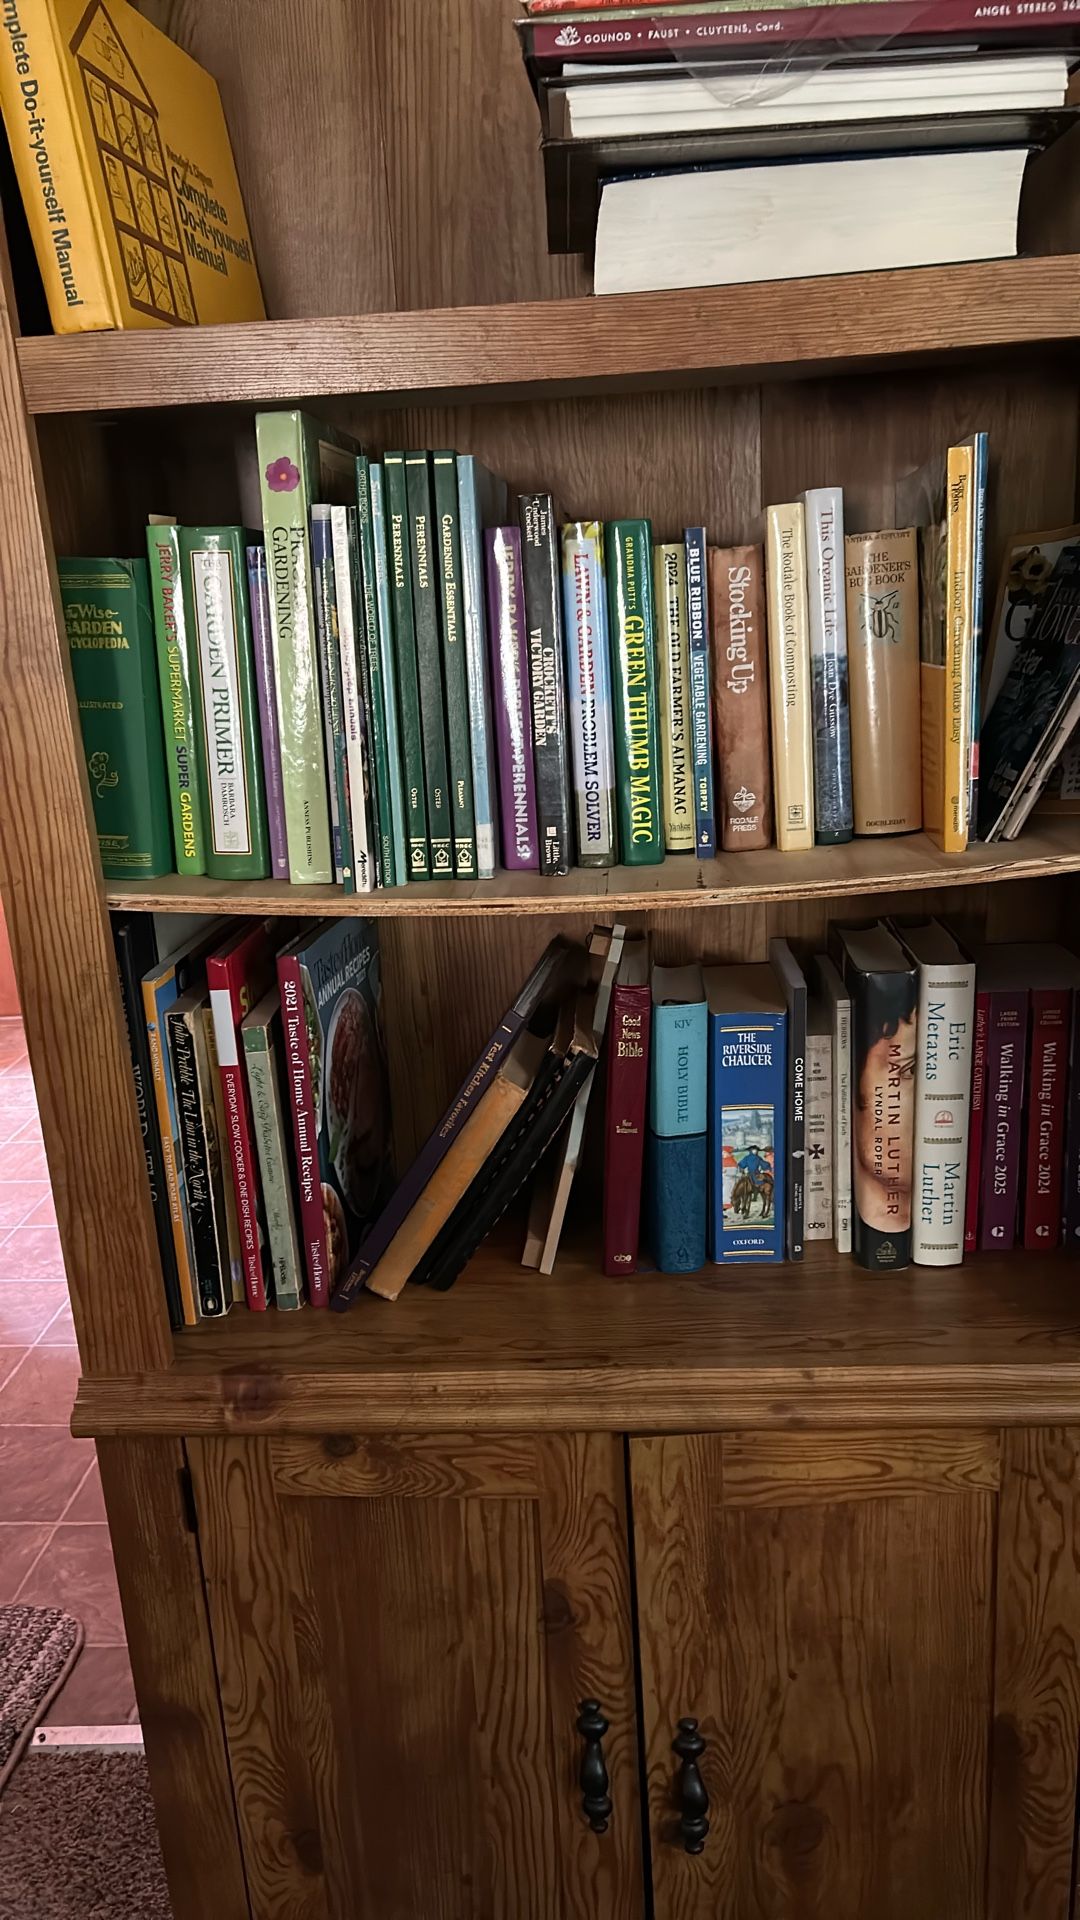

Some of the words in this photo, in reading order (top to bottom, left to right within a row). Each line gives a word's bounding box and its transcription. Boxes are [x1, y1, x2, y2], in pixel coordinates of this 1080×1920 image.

[974, 5, 1011, 17] ANGEL
[1016, 2, 1057, 14] STEREO
[584, 32, 631, 44] GOUNOD
[648, 29, 679, 40] FAUST
[756, 21, 784, 32] Cond.
[20, 79, 66, 224] Do-it-yourself
[51, 227, 84, 308] Manual
[172, 166, 229, 225] Complete
[178, 202, 251, 265] Do-it-yourself
[184, 234, 229, 277] Manual
[358, 469, 367, 496] ORTHO
[525, 506, 534, 542] Crockett
[532, 500, 541, 547] Underwood
[540, 509, 548, 536] James
[781, 528, 794, 549] The
[820, 507, 834, 542] This
[155, 542, 173, 583] JERRY
[391, 514, 405, 588] PERENNIALS
[415, 516, 429, 589] PERENNIALS
[442, 514, 454, 579] GARDENING
[625, 536, 634, 578] GRANDMA
[271, 526, 293, 640] GARDENING
[573, 553, 592, 604] LAWN
[689, 548, 701, 583] BLUE
[782, 551, 795, 590] Rodale
[817, 547, 835, 603] Organic
[875, 572, 905, 586] BOOK
[627, 581, 636, 610] PUTT'S
[784, 594, 796, 621] Book
[953, 570, 965, 612] Indoor
[78, 604, 119, 619] Wise
[160, 586, 176, 642] BAKER'S
[445, 582, 457, 642] ESSENTIALS
[575, 607, 592, 621] &
[669, 595, 680, 627] THE
[690, 586, 702, 640] RIBBON
[727, 567, 753, 662] Stocking
[785, 624, 797, 635] of
[823, 609, 836, 636] Life
[530, 628, 543, 689] VICTORY
[577, 627, 596, 695] GARDEN
[623, 615, 647, 687] GREEN
[669, 631, 681, 663] OLD
[952, 615, 965, 678] Gardening
[543, 648, 557, 735] CROCKETT'S
[693, 654, 706, 708] VEGETABLE
[727, 661, 754, 694] Up
[785, 639, 799, 707] Composting
[826, 681, 837, 700] Dye
[166, 646, 186, 741] SUPERMARKET
[670, 667, 684, 741] FARMER'S
[952, 682, 962, 714] Made
[211, 686, 235, 776] PRIMER
[532, 690, 547, 747] GARDEN
[625, 692, 650, 771] THUMB
[828, 703, 838, 739] Gussow
[950, 717, 961, 744] Easy
[581, 698, 599, 777] PROBLEM
[694, 711, 708, 765] GARDENING
[175, 745, 190, 788] SUPER
[672, 746, 687, 815] ALMANAC
[220, 782, 231, 826] DAMROSCH
[227, 782, 237, 818] BARBARA
[584, 781, 602, 842] SOLVER
[629, 775, 653, 844] MAGIC
[699, 777, 708, 812] TORPEY
[180, 791, 196, 857] GARDENS
[730, 816, 760, 825] RODALE
[732, 824, 757, 832] PRESS
[304, 826, 313, 867] PUBLISHING
[382, 835, 390, 858] SOUTH
[544, 840, 554, 864] Brown
[357, 850, 368, 888] Meredith
[384, 858, 392, 884] EDITION
[284, 981, 298, 1012] 2021
[318, 970, 346, 1010] ANNUAL
[345, 946, 371, 982] RECIPES
[169, 1017, 187, 1045] John
[287, 1015, 300, 1049] Taste
[622, 1015, 641, 1026] Good
[622, 1028, 641, 1039] News
[674, 1019, 693, 1029] KJV
[737, 1032, 757, 1043] THE
[291, 1052, 304, 1067] of
[485, 1041, 503, 1062] Test
[617, 1041, 644, 1057] Bible
[722, 1044, 772, 1055] RIVERSIDE
[925, 1001, 945, 1081] Metaxas
[948, 1022, 966, 1061] Eric
[175, 1045, 192, 1085] Prebble
[677, 1046, 689, 1081] HOLY
[722, 1055, 773, 1067] CHAUCER
[794, 1057, 804, 1088] COME
[995, 1043, 1013, 1101] Walking
[1038, 1042, 1057, 1100] Walking
[225, 1073, 238, 1113] EVERYDAY
[292, 1069, 307, 1106] Home
[463, 1062, 490, 1098] Kitchen
[887, 1043, 902, 1125] MARTIN
[181, 1088, 196, 1111] The
[439, 1098, 469, 1138] Favorites
[677, 1085, 689, 1123] BIBLE
[794, 1091, 803, 1121] HOME
[873, 1086, 883, 1132] LYNDAL
[997, 1104, 1011, 1118] in
[1041, 1103, 1054, 1116] in
[184, 1112, 198, 1136] Lion
[187, 1137, 198, 1148] in
[230, 1115, 242, 1139] SLOW
[295, 1108, 312, 1152] Annual
[996, 1121, 1010, 1161] Grace
[1039, 1120, 1053, 1161] Grace
[164, 1154, 171, 1163] TO
[188, 1149, 201, 1164] the
[233, 1139, 244, 1173] COOKER
[873, 1137, 883, 1177] ROPER
[188, 1164, 207, 1201] North
[238, 1181, 247, 1199] ONE
[300, 1155, 314, 1202] Recipes
[886, 1137, 901, 1215] LUTHER
[921, 1163, 939, 1224] Luther
[942, 1162, 960, 1226] Martin
[994, 1165, 1007, 1195] 2025
[1037, 1164, 1051, 1195] 2024
[240, 1199, 250, 1218] DISH
[243, 1219, 254, 1250] RECIPES
